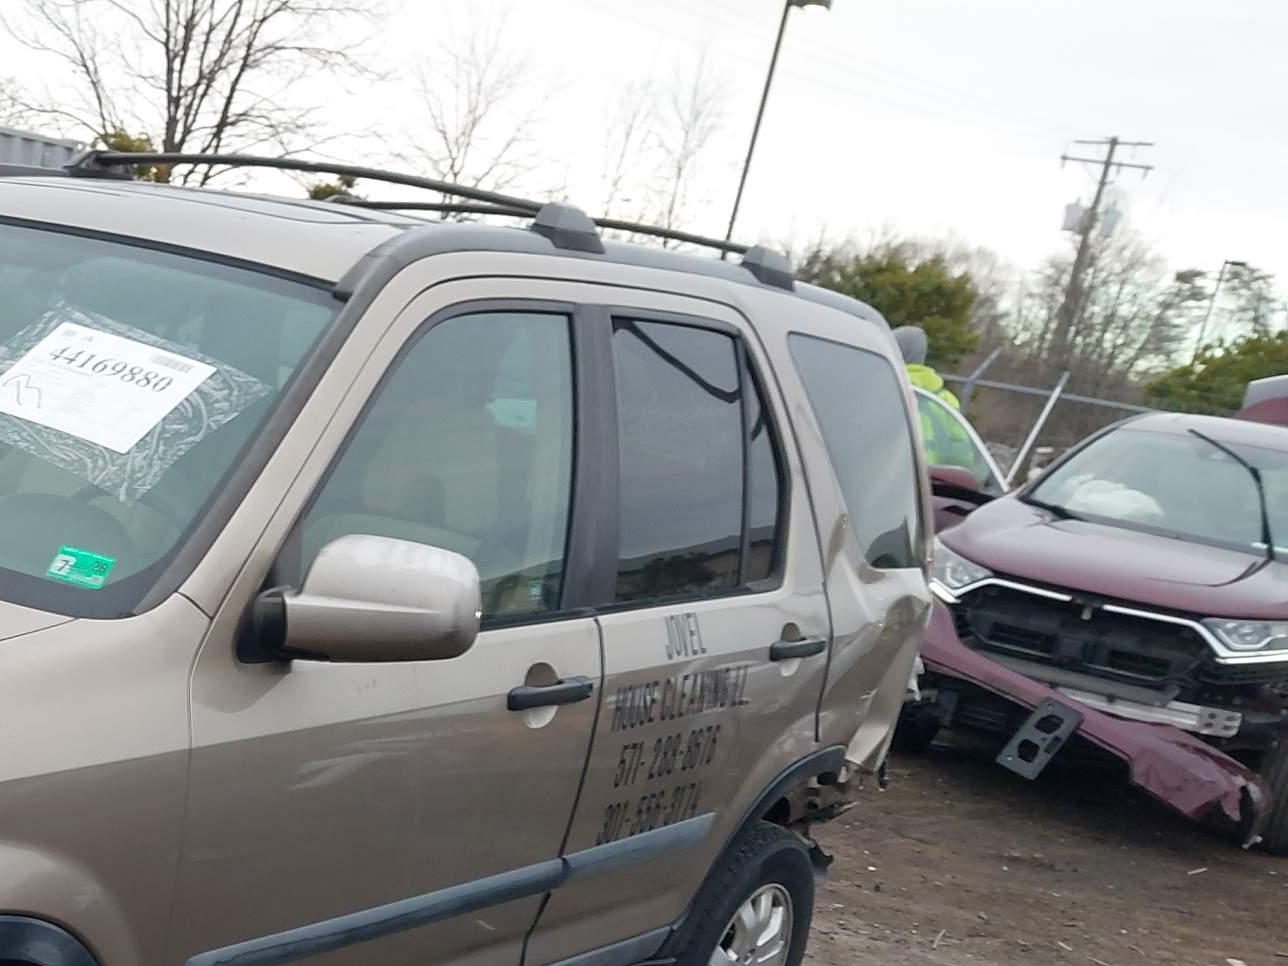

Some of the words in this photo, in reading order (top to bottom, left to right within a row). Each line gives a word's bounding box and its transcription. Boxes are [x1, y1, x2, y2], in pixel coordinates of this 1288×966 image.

[49, 345, 174, 393] 44169880
[665, 612, 708, 660] JOVEL
[611, 681, 660, 732] HOUSE
[661, 666, 732, 721] CLEANING
